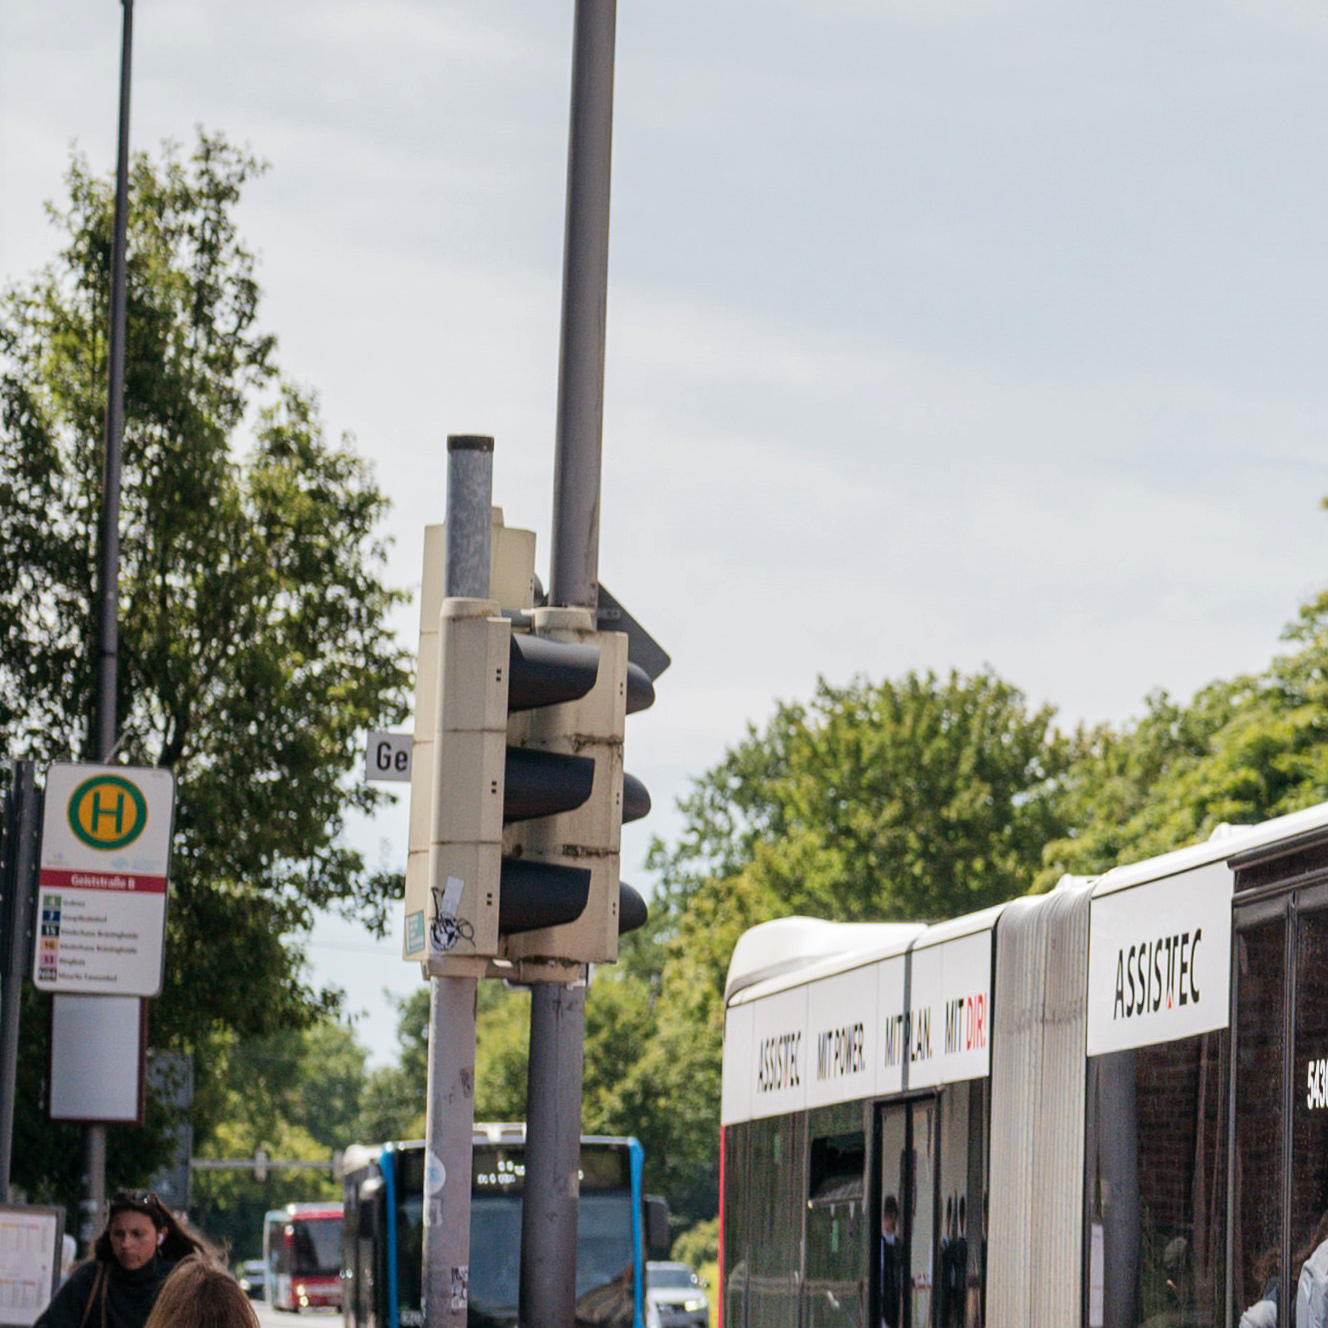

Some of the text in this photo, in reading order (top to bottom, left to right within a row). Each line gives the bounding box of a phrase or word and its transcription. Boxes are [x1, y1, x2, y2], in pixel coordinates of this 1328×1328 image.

[376, 741, 408, 771] Ge
[91, 791, 124, 834] H
[1114, 928, 1202, 1020] ASSISTEC
[757, 1031, 801, 1093] ASSISTEC
[817, 1030, 833, 1081] MIT
[834, 1021, 866, 1078] POWER.
[885, 1015, 903, 1068] MIT
[945, 998, 964, 1055] MIT
[966, 993, 987, 1051] DIR!
